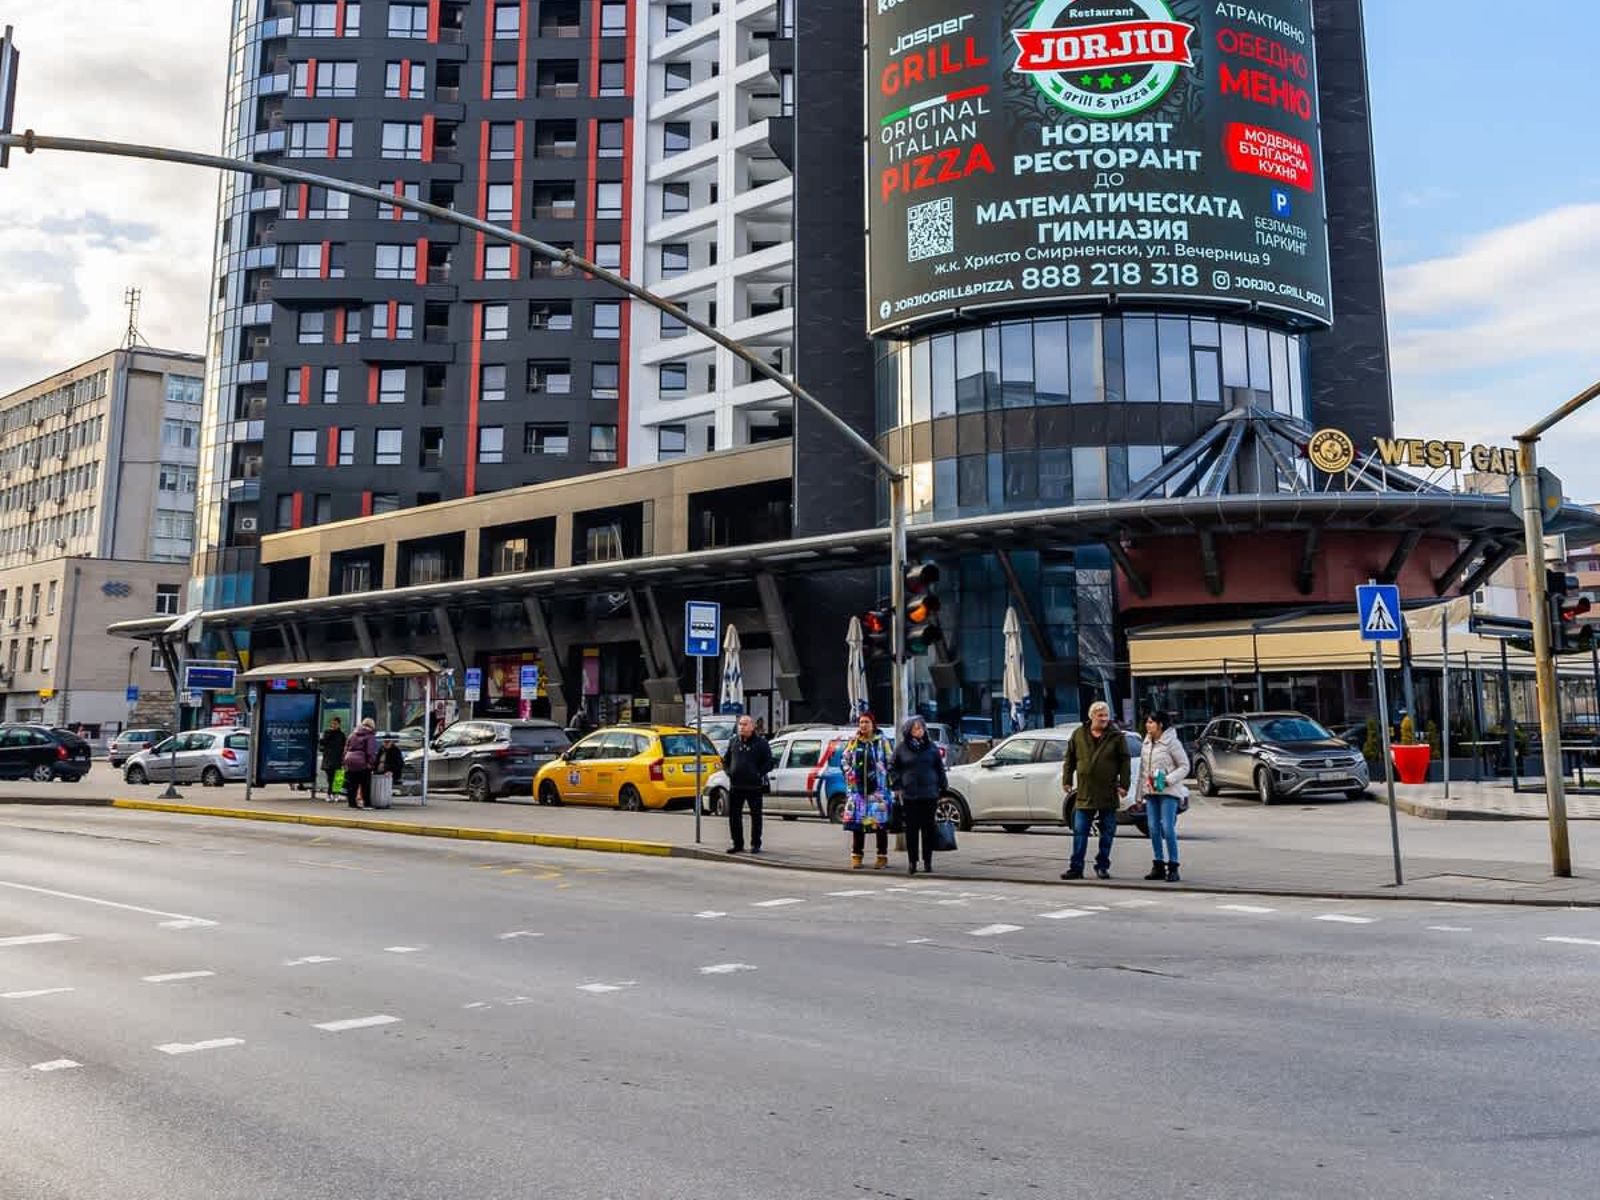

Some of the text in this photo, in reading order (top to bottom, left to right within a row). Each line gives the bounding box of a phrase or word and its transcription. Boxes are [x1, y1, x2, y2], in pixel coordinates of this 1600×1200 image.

[1069, 7, 1134, 19] Restaurant
[1215, 1, 1305, 45] АТРАКТИВНО
[1029, 28, 1174, 63] JORJIO
[1216, 27, 1308, 79] ОБЕДНО
[880, 36, 990, 96] GRILL
[1063, 90, 1092, 107] grill
[1111, 86, 1149, 109] pizza
[1218, 62, 1311, 120] МЕНЮ
[880, 97, 990, 144] ORIGINAL
[1042, 122, 1173, 146] НОВИЯТ
[889, 121, 977, 163] ITALIAN
[1239, 141, 1308, 171] БЪЛГАРСКА
[1244, 129, 1304, 155] МОДЕРНА
[880, 143, 995, 204] PIZZA
[1014, 148, 1202, 176] РЕСТОРАНТ
[1258, 159, 1297, 180] КУХНЯ
[1094, 172, 1125, 189] ДО
[976, 192, 1244, 225] МАТЕМАТИЧЕСКАТА
[1275, 193, 1287, 212] P
[1038, 219, 1188, 243] ГИМНАЗИЯ
[1255, 216, 1308, 240] БЕЗПЛАТЕН
[1255, 231, 1308, 255] ПАРКИНГ
[935, 243, 1271, 275] ж.к. Христо Смирненски, ул. Вечерница 9
[1021, 263, 1199, 290] 888 218 318
[895, 279, 1014, 311] JORJIOGRILL&PIZZA
[1375, 437, 1466, 469] WEST
